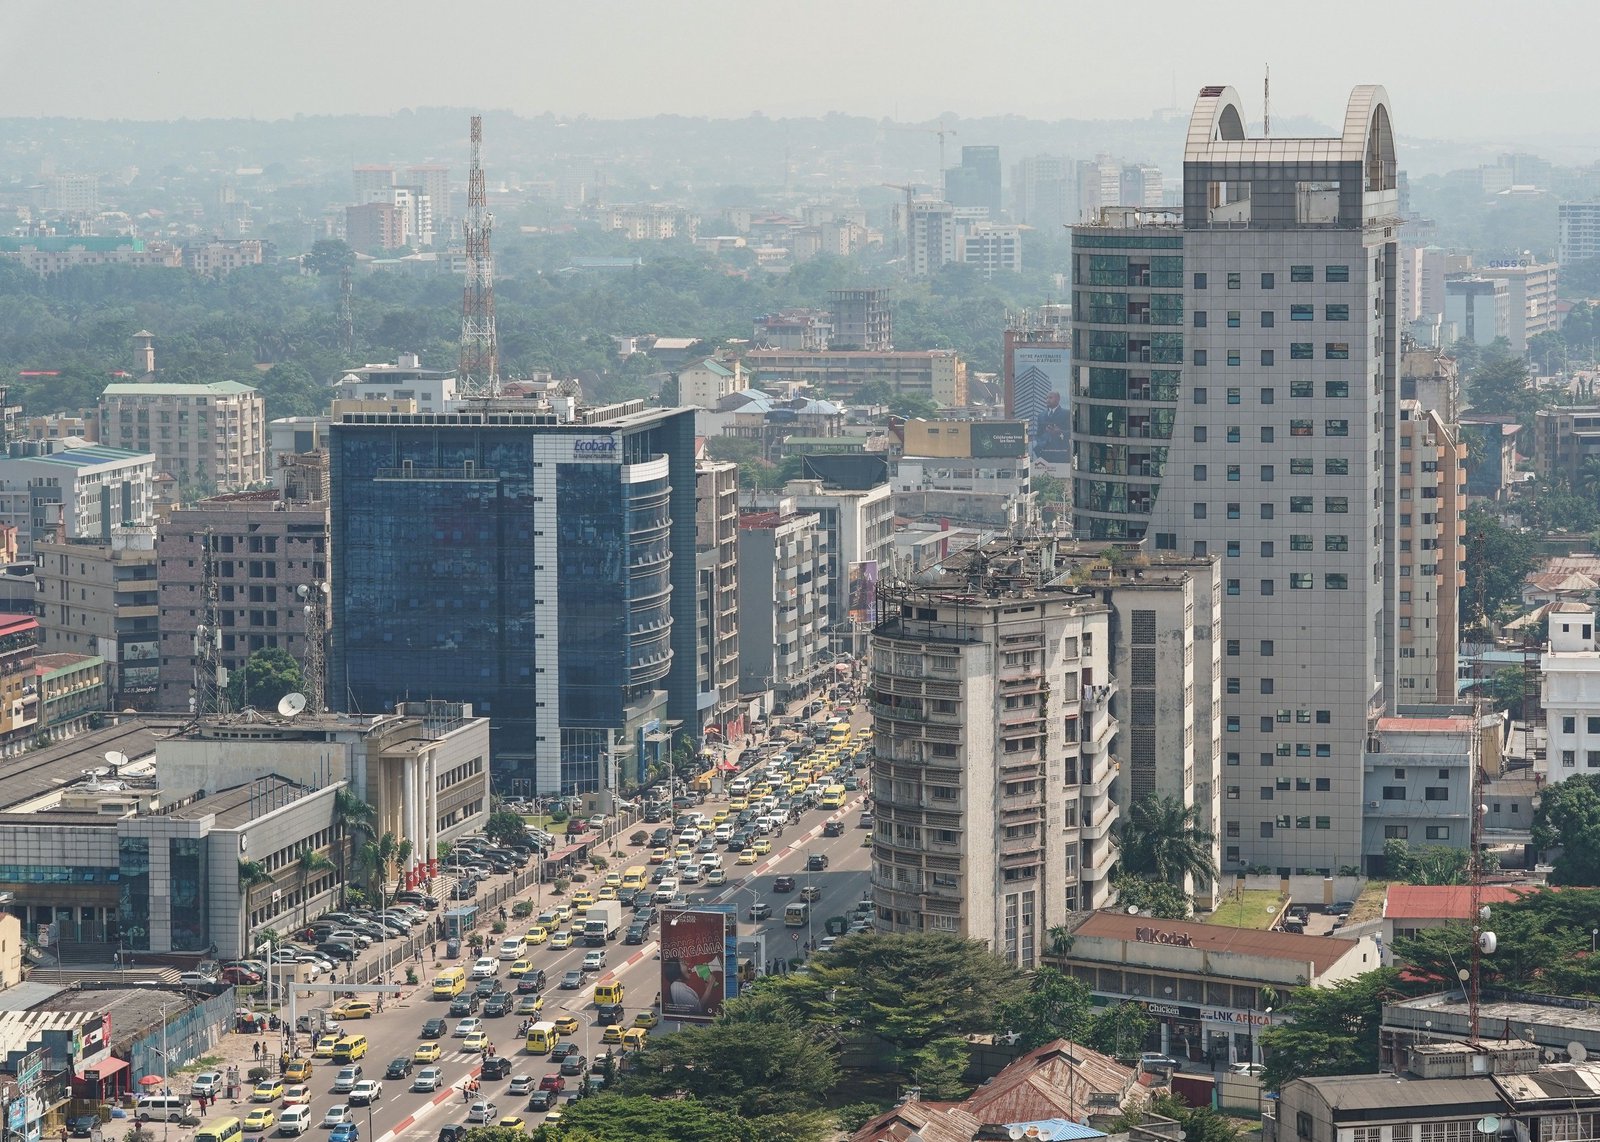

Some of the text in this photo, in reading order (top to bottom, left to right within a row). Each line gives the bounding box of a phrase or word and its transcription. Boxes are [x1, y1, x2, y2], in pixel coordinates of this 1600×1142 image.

[574, 437, 617, 452] Ecobank
[1149, 928, 1194, 947] Kodak
[1148, 1003, 1179, 1015] Chicken
[1213, 1010, 1233, 1021] LNK
[1235, 1013, 1270, 1025] AFRICA
